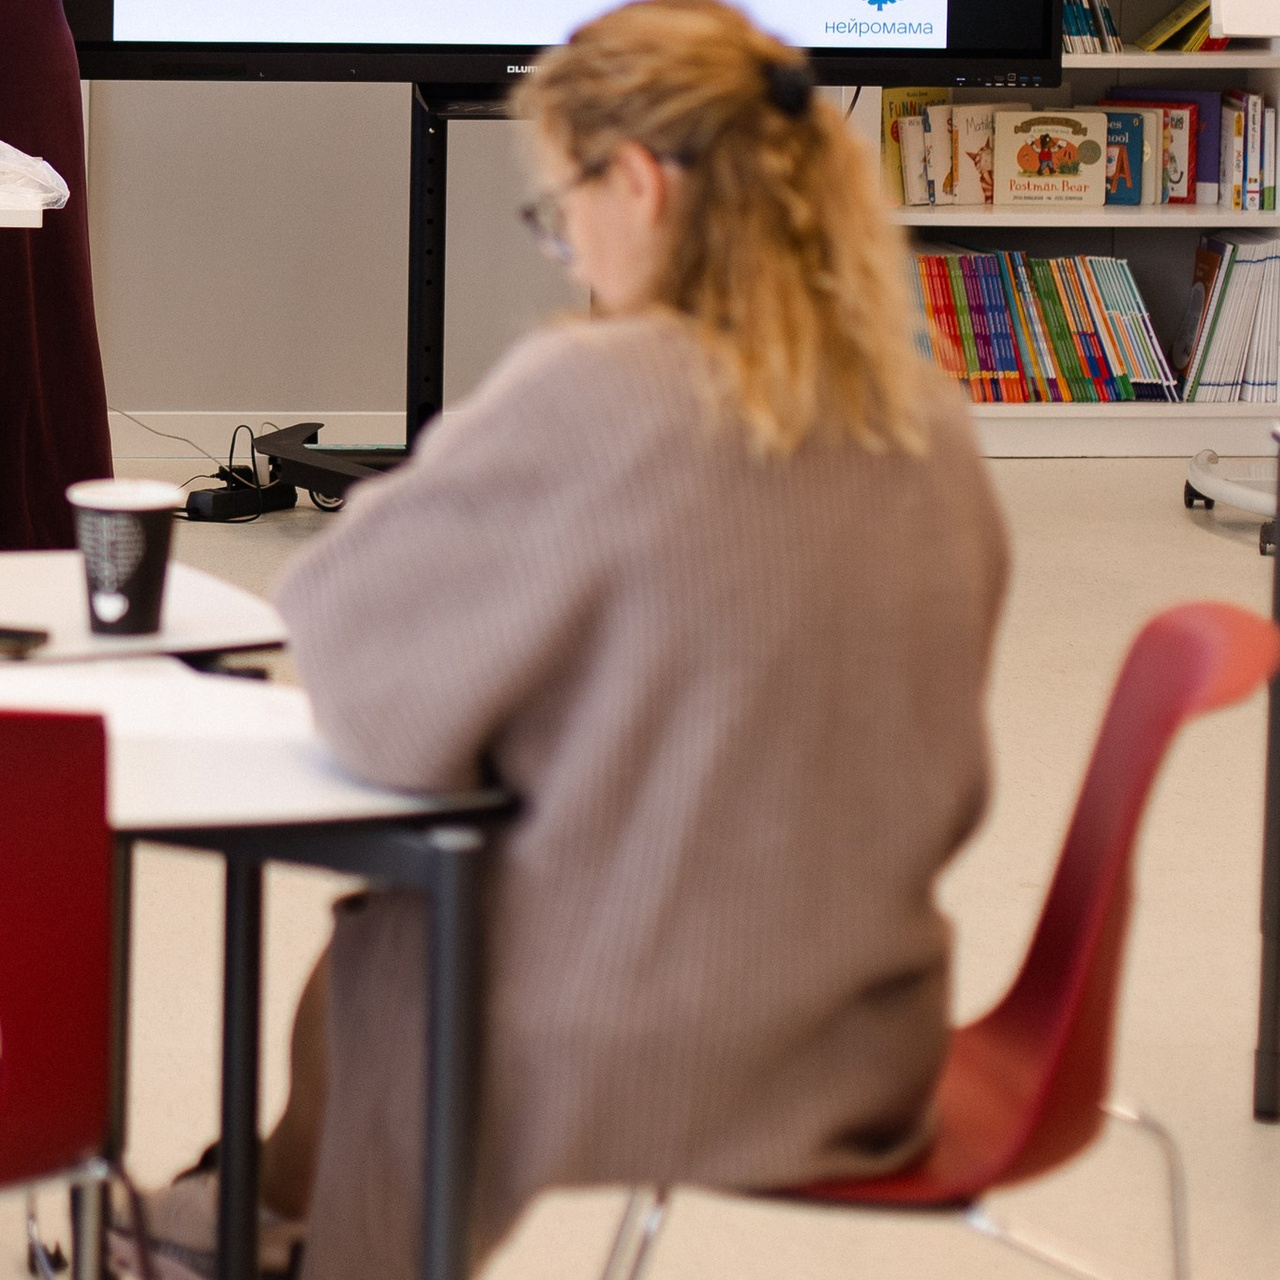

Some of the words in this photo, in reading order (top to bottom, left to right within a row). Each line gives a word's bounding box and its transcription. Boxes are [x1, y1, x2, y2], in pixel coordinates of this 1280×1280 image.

[824, 17, 934, 38] нейромама
[1009, 179, 1058, 192] Postman
[1062, 179, 1090, 192] Bear
